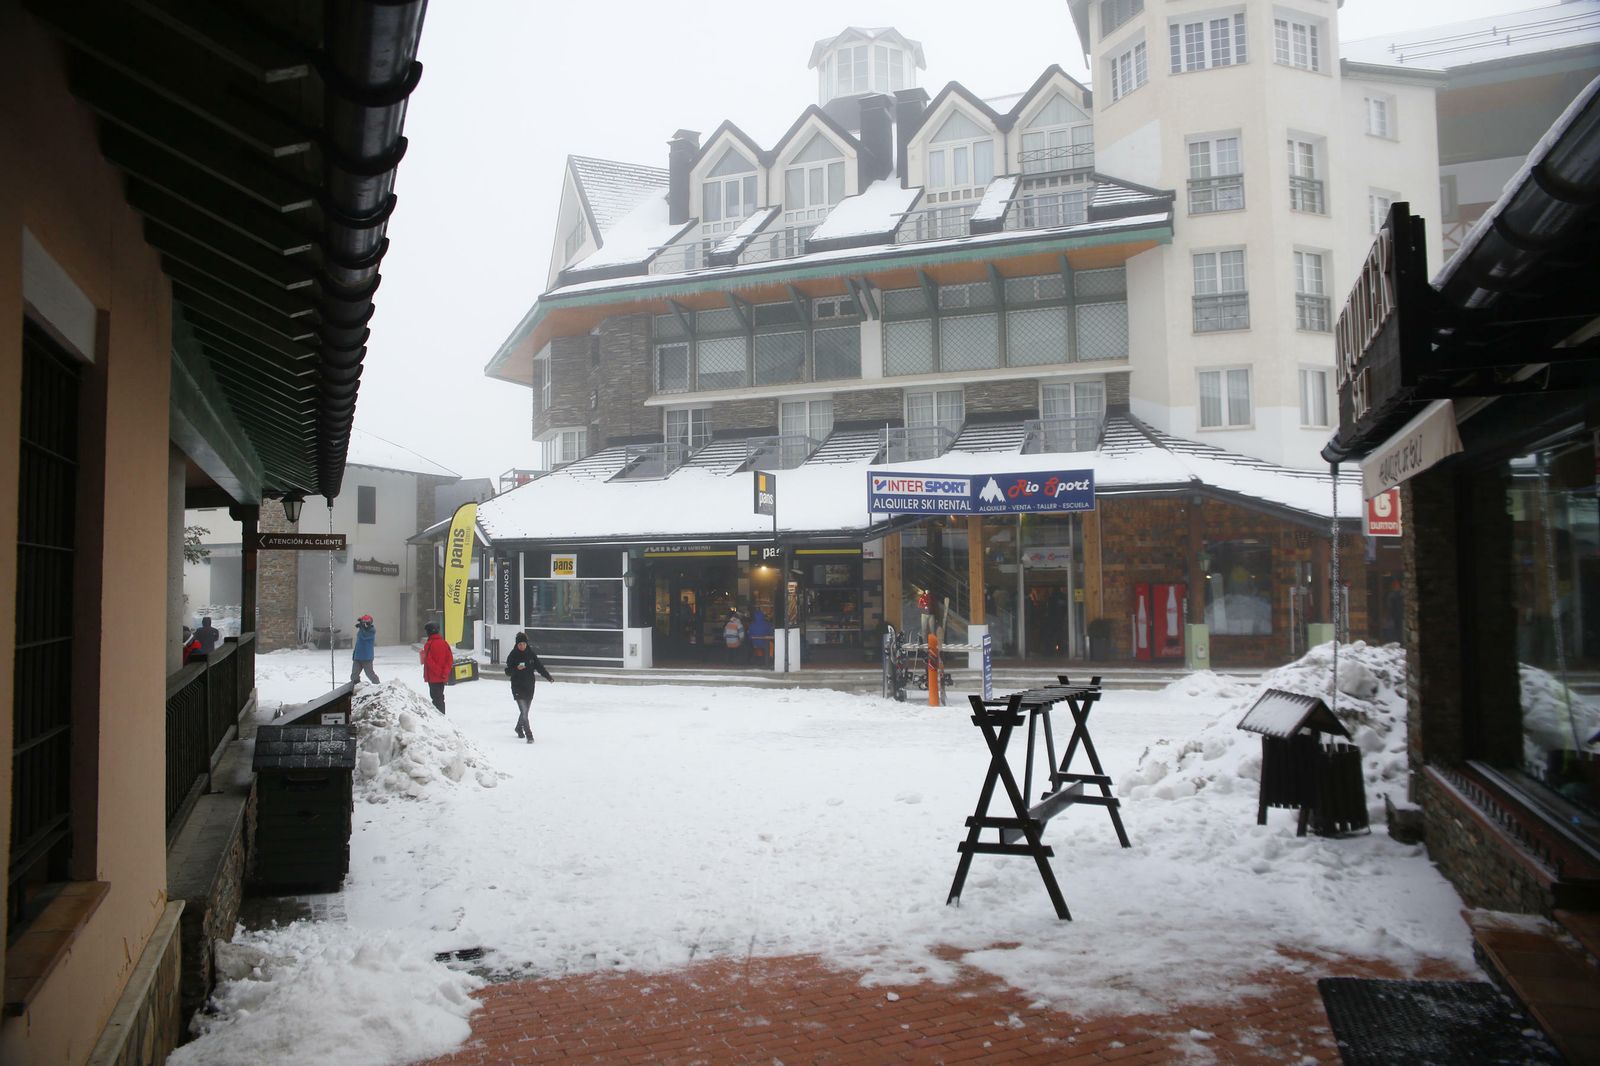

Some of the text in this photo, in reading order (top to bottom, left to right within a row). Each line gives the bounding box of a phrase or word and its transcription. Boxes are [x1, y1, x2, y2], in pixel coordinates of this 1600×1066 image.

[1352, 367, 1370, 423] SKI
[1008, 476, 1090, 498] Rio Sport
[759, 492, 774, 507] pans
[873, 498, 971, 511] ALQUILER SKI RENTAL
[451, 528, 465, 569] pans
[553, 560, 574, 572] pans
[453, 578, 462, 605] pans
